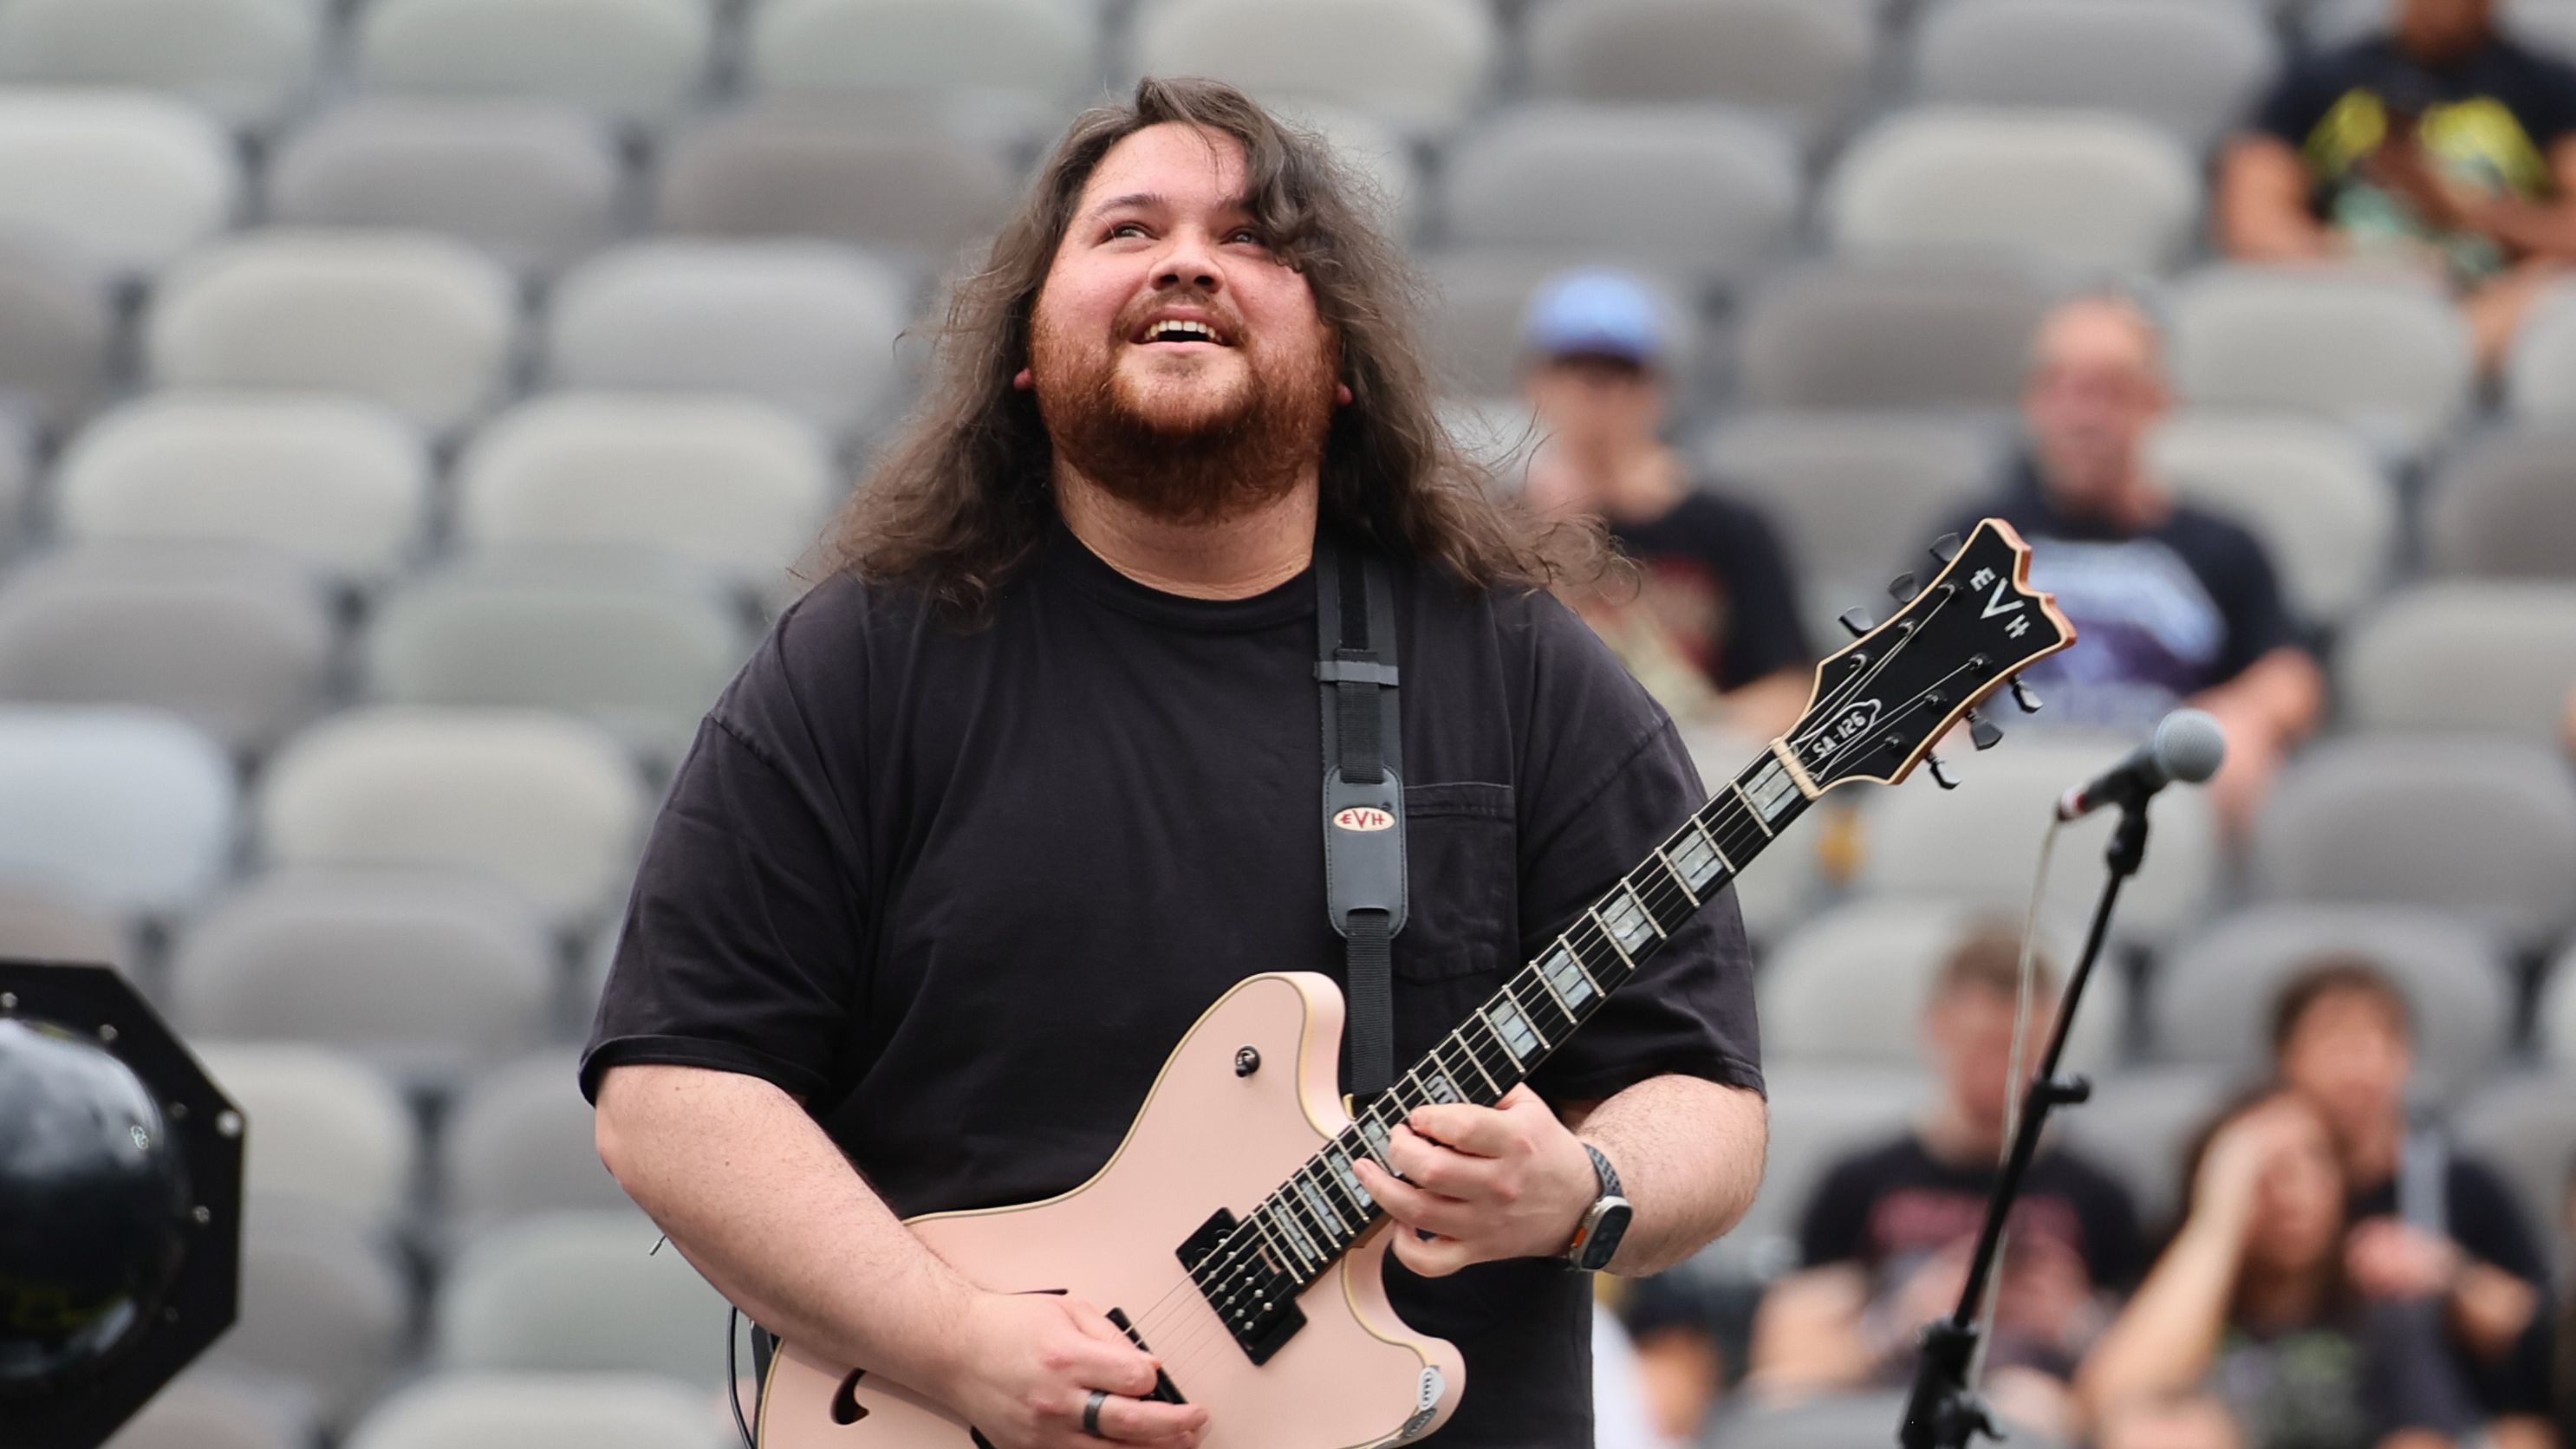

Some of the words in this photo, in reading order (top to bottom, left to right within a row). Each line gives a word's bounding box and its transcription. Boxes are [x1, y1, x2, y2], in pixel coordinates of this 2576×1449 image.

[1969, 566, 2031, 640] EVH
[1812, 711, 1866, 758] SA-126
[1339, 809, 1385, 828] EVH
